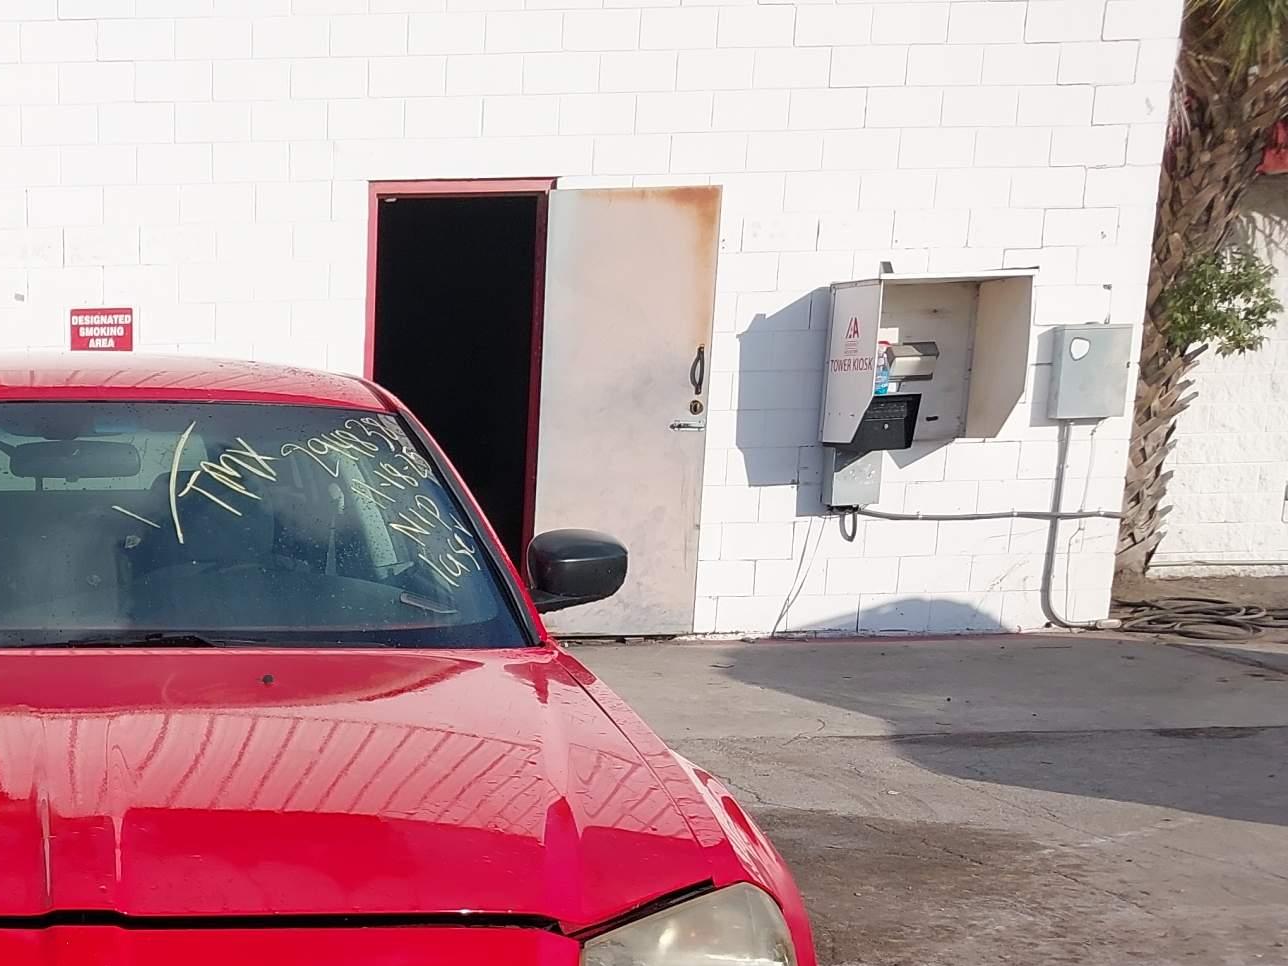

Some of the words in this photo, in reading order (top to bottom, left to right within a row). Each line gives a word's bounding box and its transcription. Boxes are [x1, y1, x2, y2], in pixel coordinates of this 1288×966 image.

[72, 314, 131, 325] DESIGNATED
[79, 326, 124, 336] SMOKING
[89, 338, 115, 348] AREA
[831, 359, 851, 372] TOWER
[853, 357, 873, 371] KIOSK
